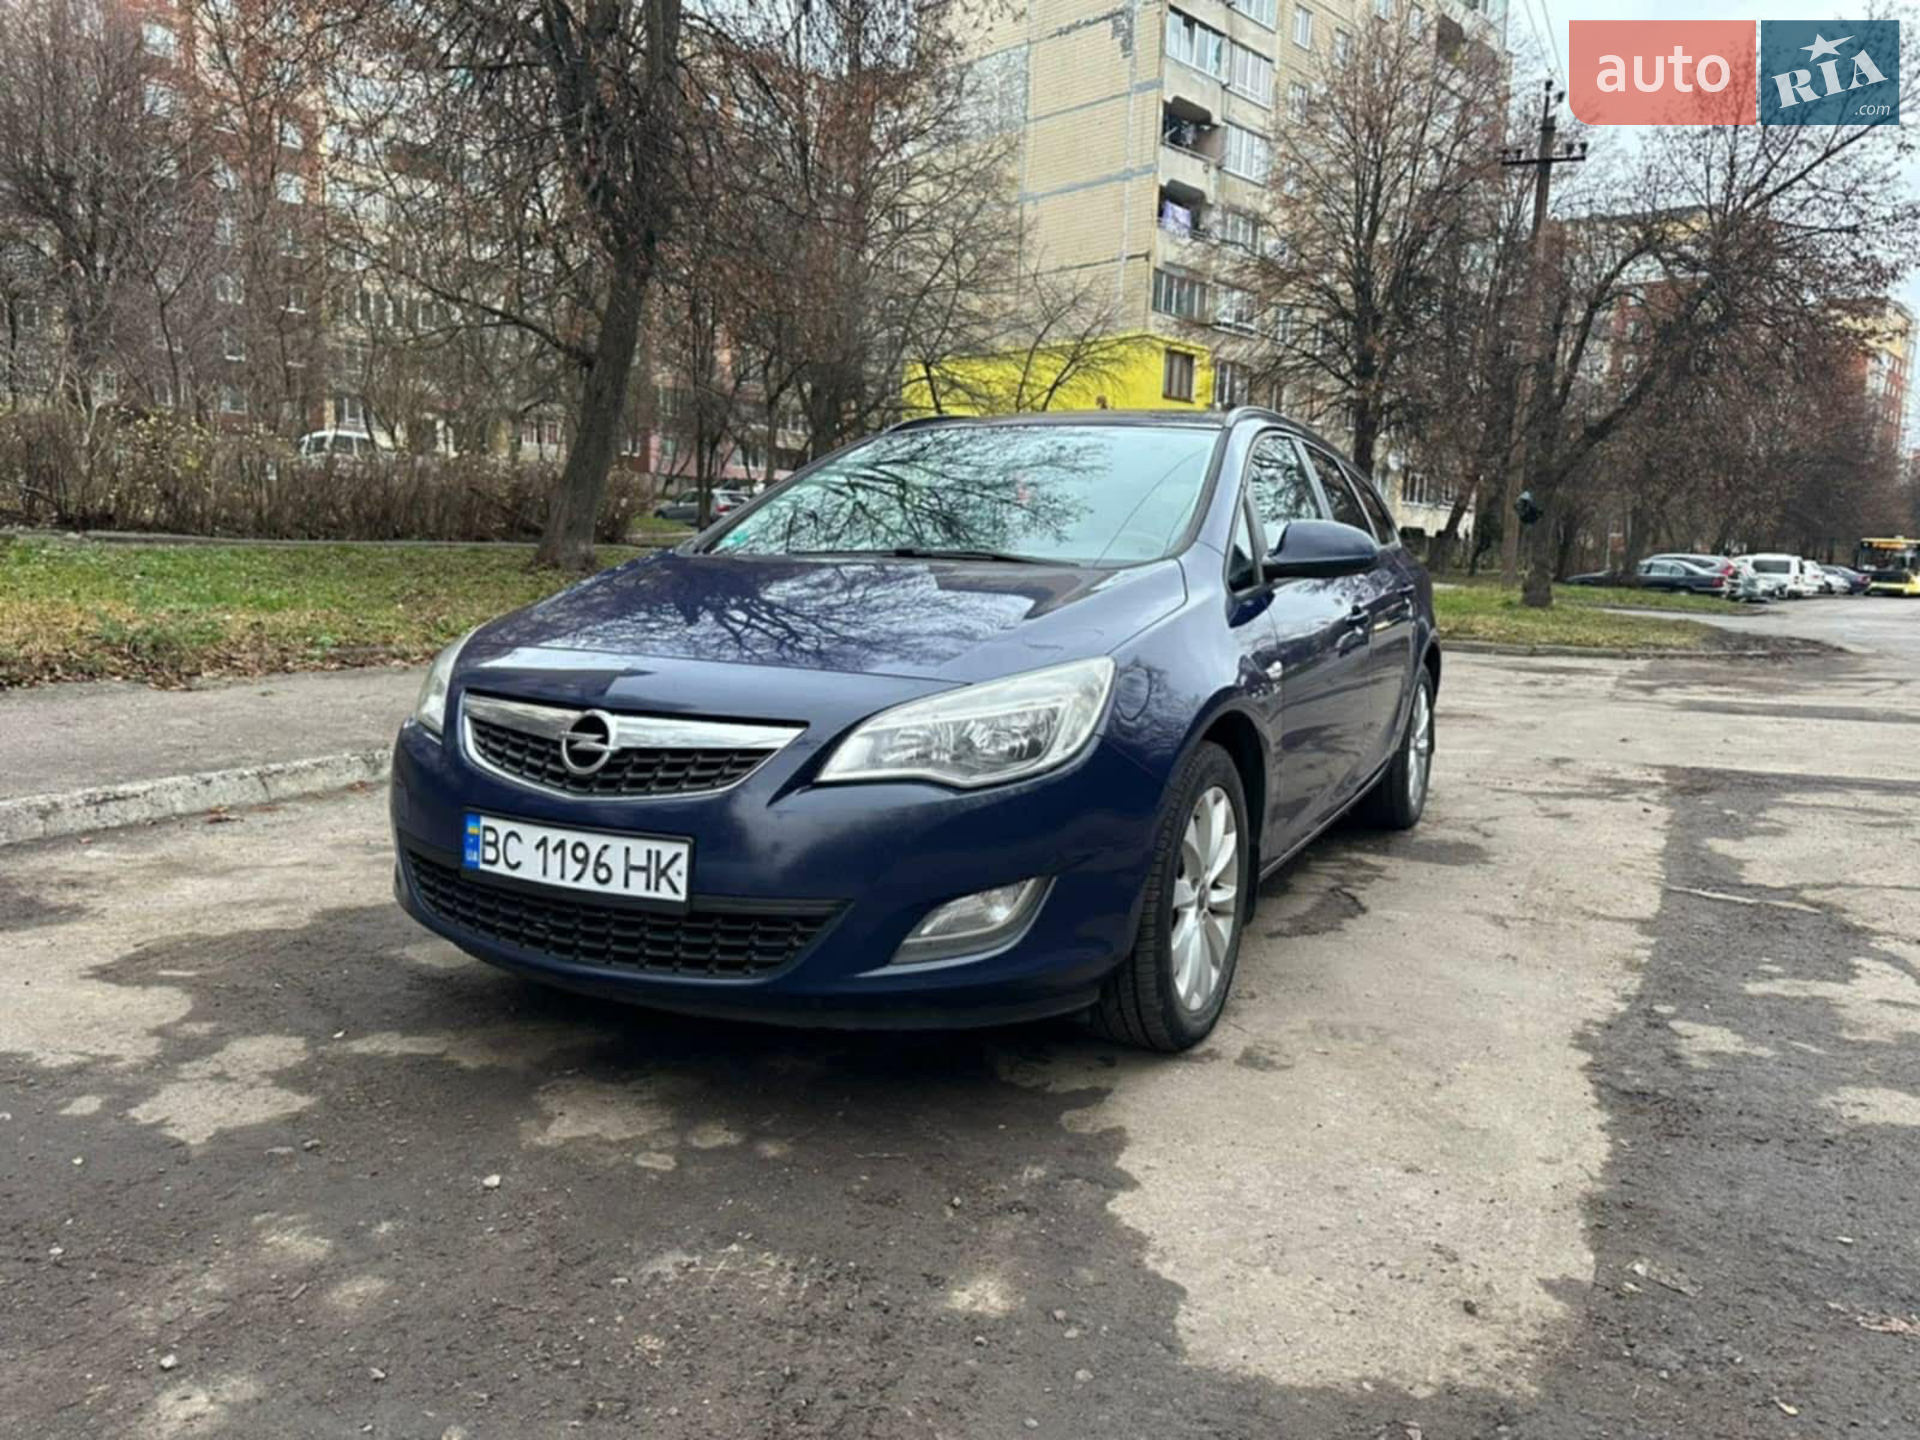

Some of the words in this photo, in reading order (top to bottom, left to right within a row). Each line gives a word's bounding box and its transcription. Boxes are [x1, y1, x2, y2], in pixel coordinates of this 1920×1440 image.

[481, 825, 523, 871] BC
[534, 835, 614, 885] 1196
[623, 846, 683, 896] HK
